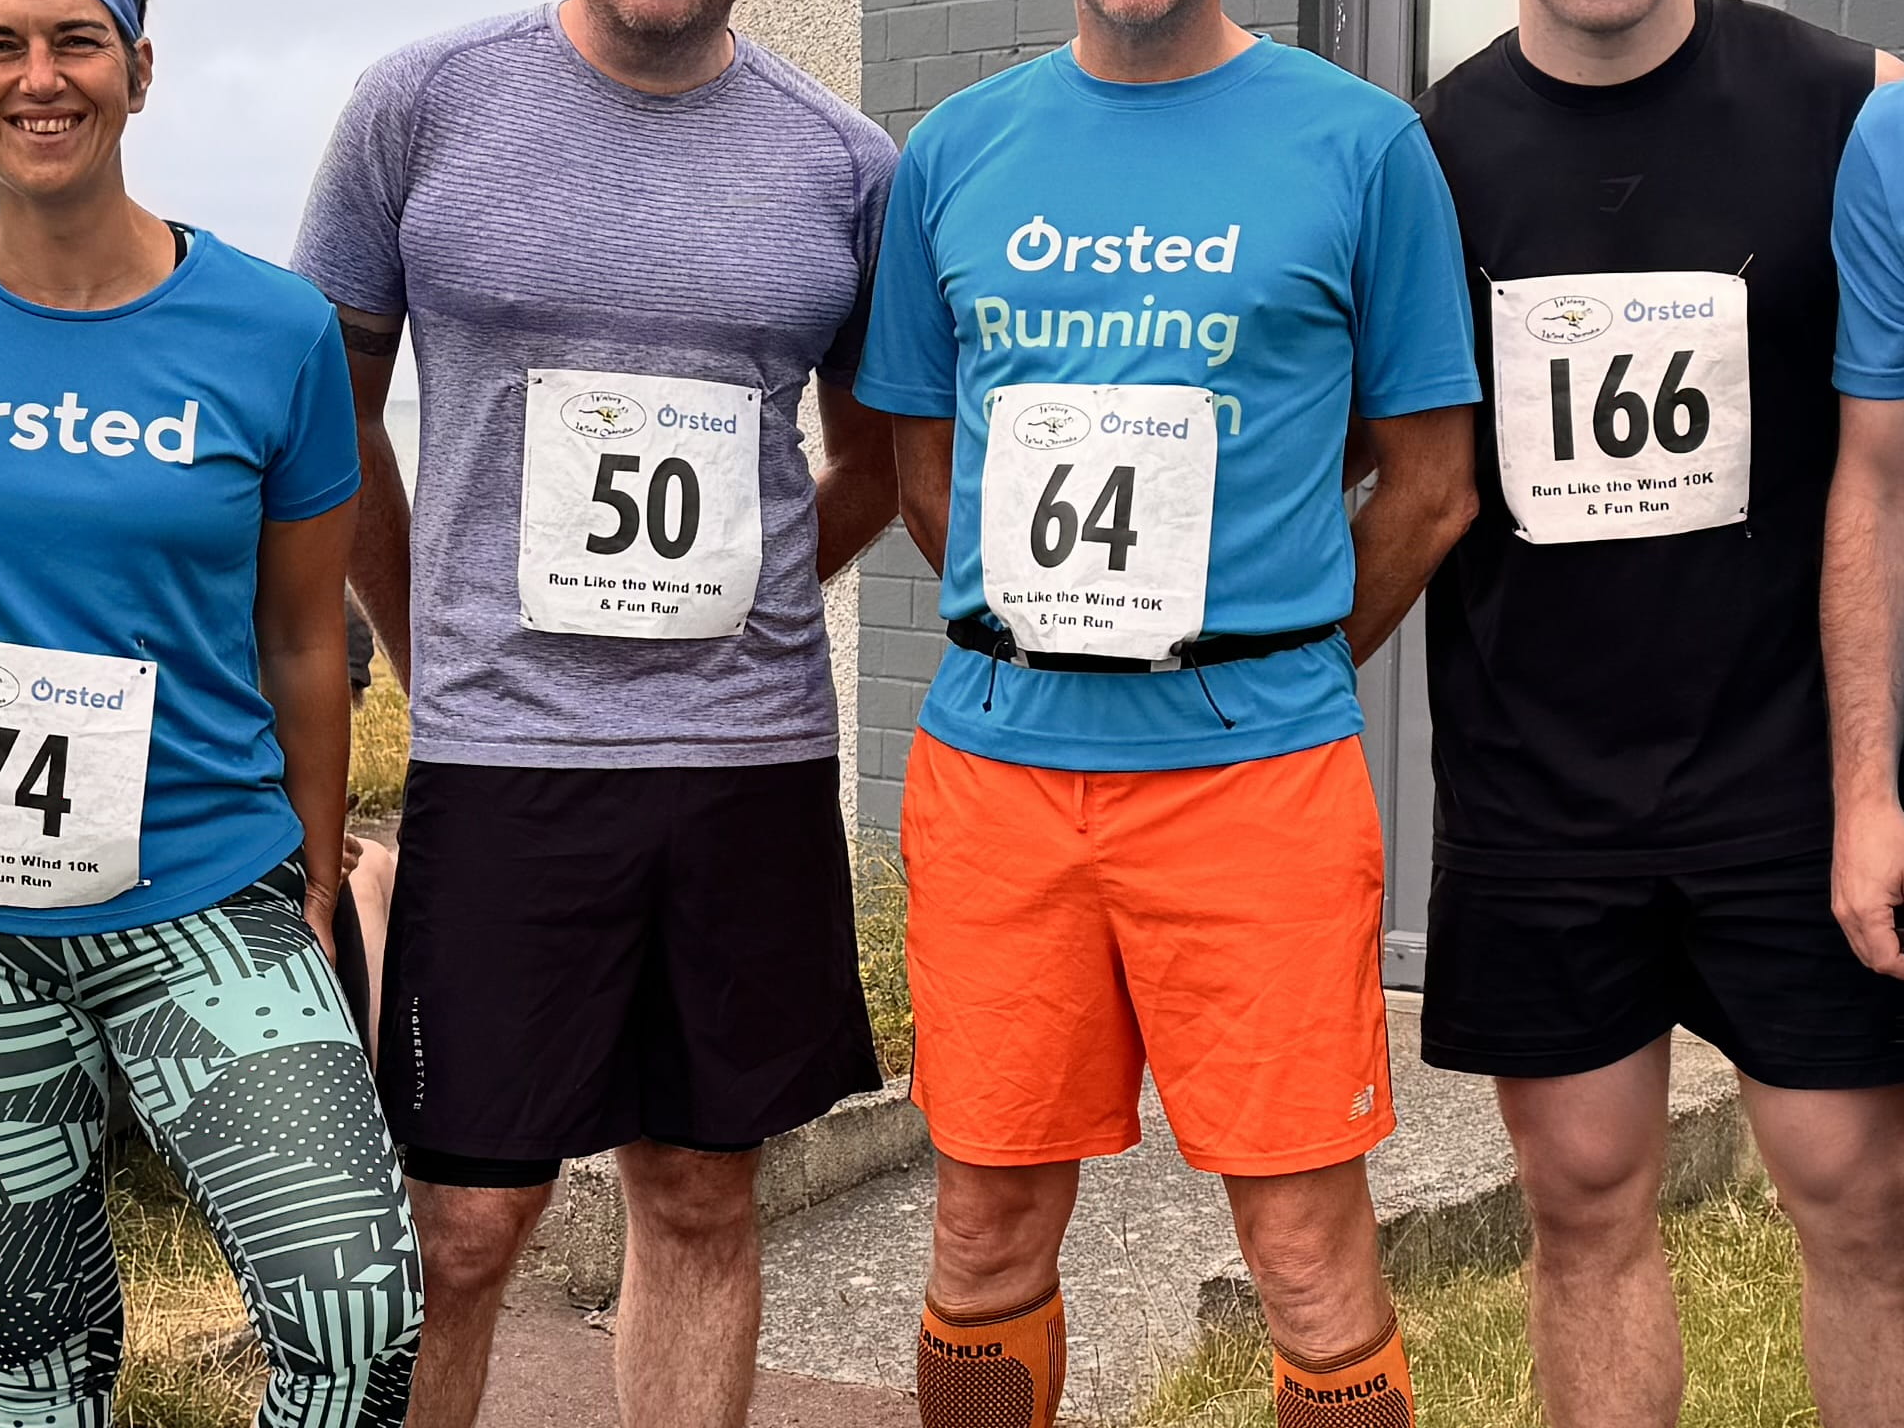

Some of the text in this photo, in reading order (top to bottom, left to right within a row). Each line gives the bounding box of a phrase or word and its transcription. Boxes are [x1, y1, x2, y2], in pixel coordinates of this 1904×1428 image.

[1006, 215, 1241, 273] Ørsted
[1624, 297, 1714, 322] Ørsted
[975, 294, 1240, 367] Running
[657, 404, 737, 434] Ørsted
[1550, 350, 1710, 461] 166
[1100, 411, 1189, 439] Ørsted
[1532, 472, 1714, 497] Run Like the Wind 10K
[586, 453, 700, 559] 50
[1030, 464, 1138, 571] 64
[1587, 500, 1670, 515] & Fun Run
[549, 573, 722, 596] Run Like the Wind 10K
[600, 599, 679, 614] & Fun Run
[1003, 591, 1163, 611] Run Like the Wind 10K
[1039, 614, 1114, 629] & Fun Run
[31, 677, 124, 710] Ørsted
[22, 855, 61, 870] Wind
[68, 861, 99, 873] 10K
[21, 875, 52, 887] Run
[922, 1329, 1003, 1359] ARHUG
[1284, 1372, 1388, 1404] BEARHUG
